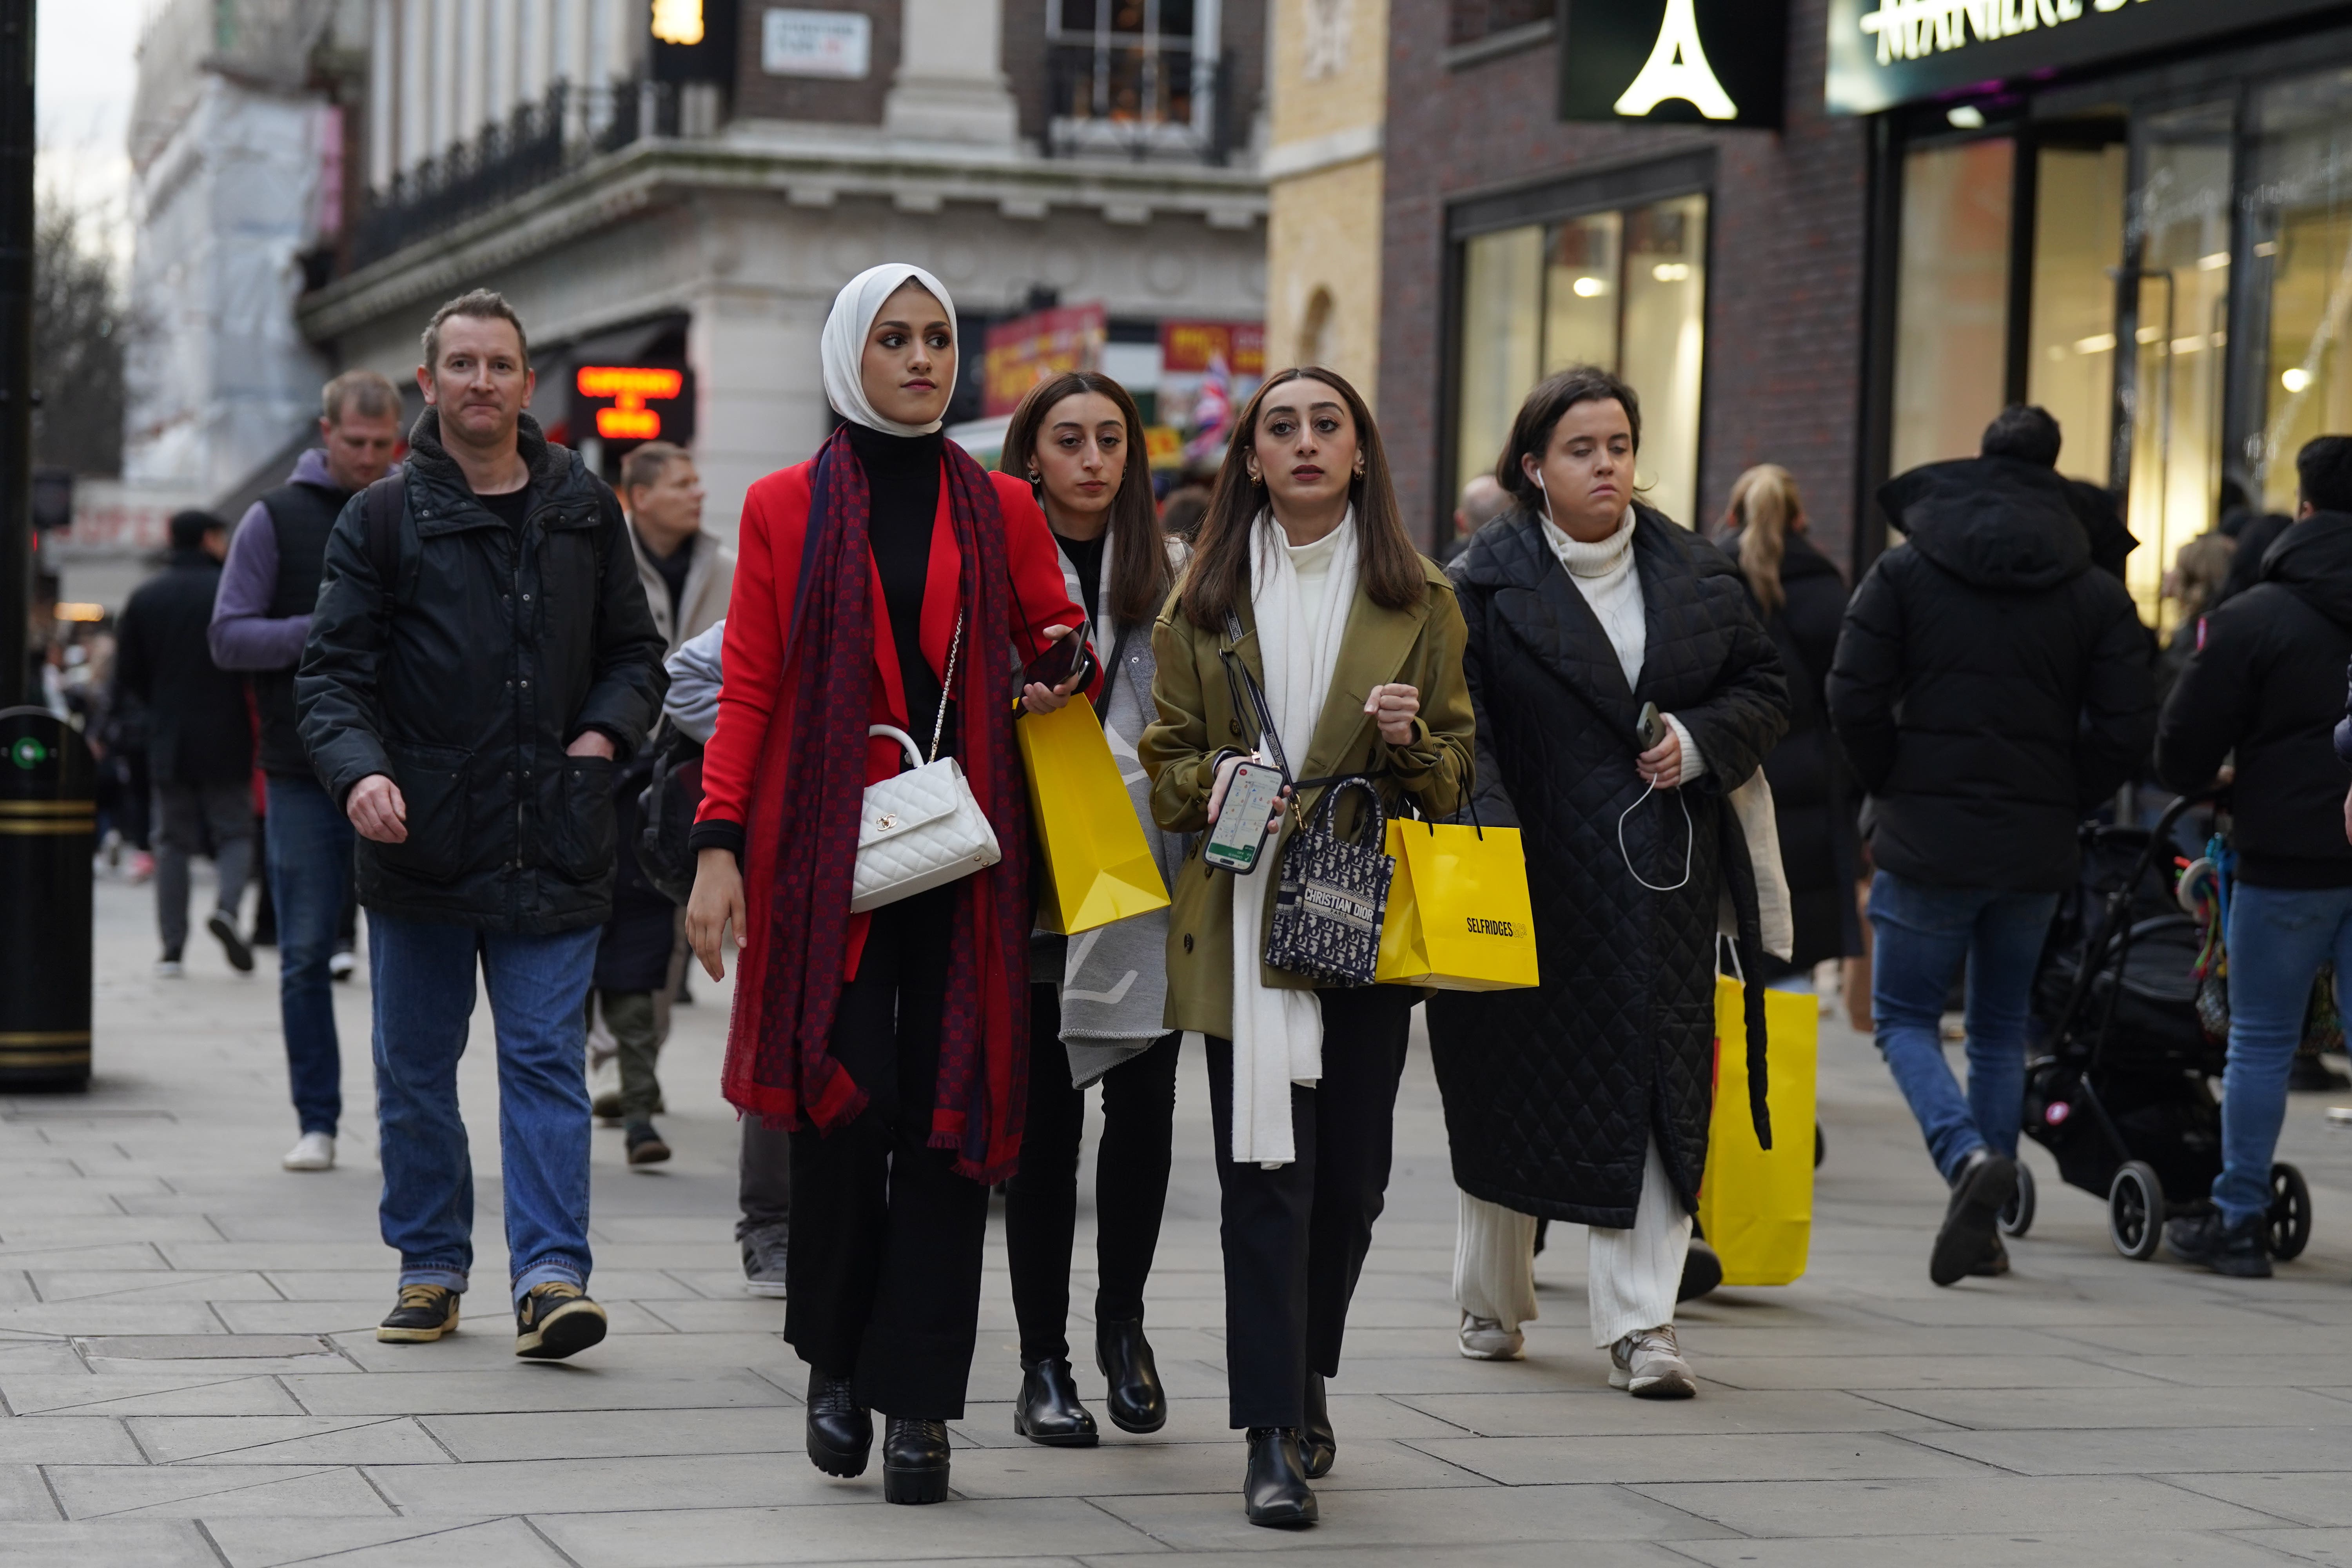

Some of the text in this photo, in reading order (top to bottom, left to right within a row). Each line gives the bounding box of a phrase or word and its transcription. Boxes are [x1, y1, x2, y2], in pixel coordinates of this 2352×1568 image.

[1230, 617, 1240, 638] CHRISTIAN
[1268, 733, 1280, 756] CHRISTIAN
[1304, 887, 1374, 922] CHRISTIAN DIOR
[1330, 909, 1347, 918] PARIS
